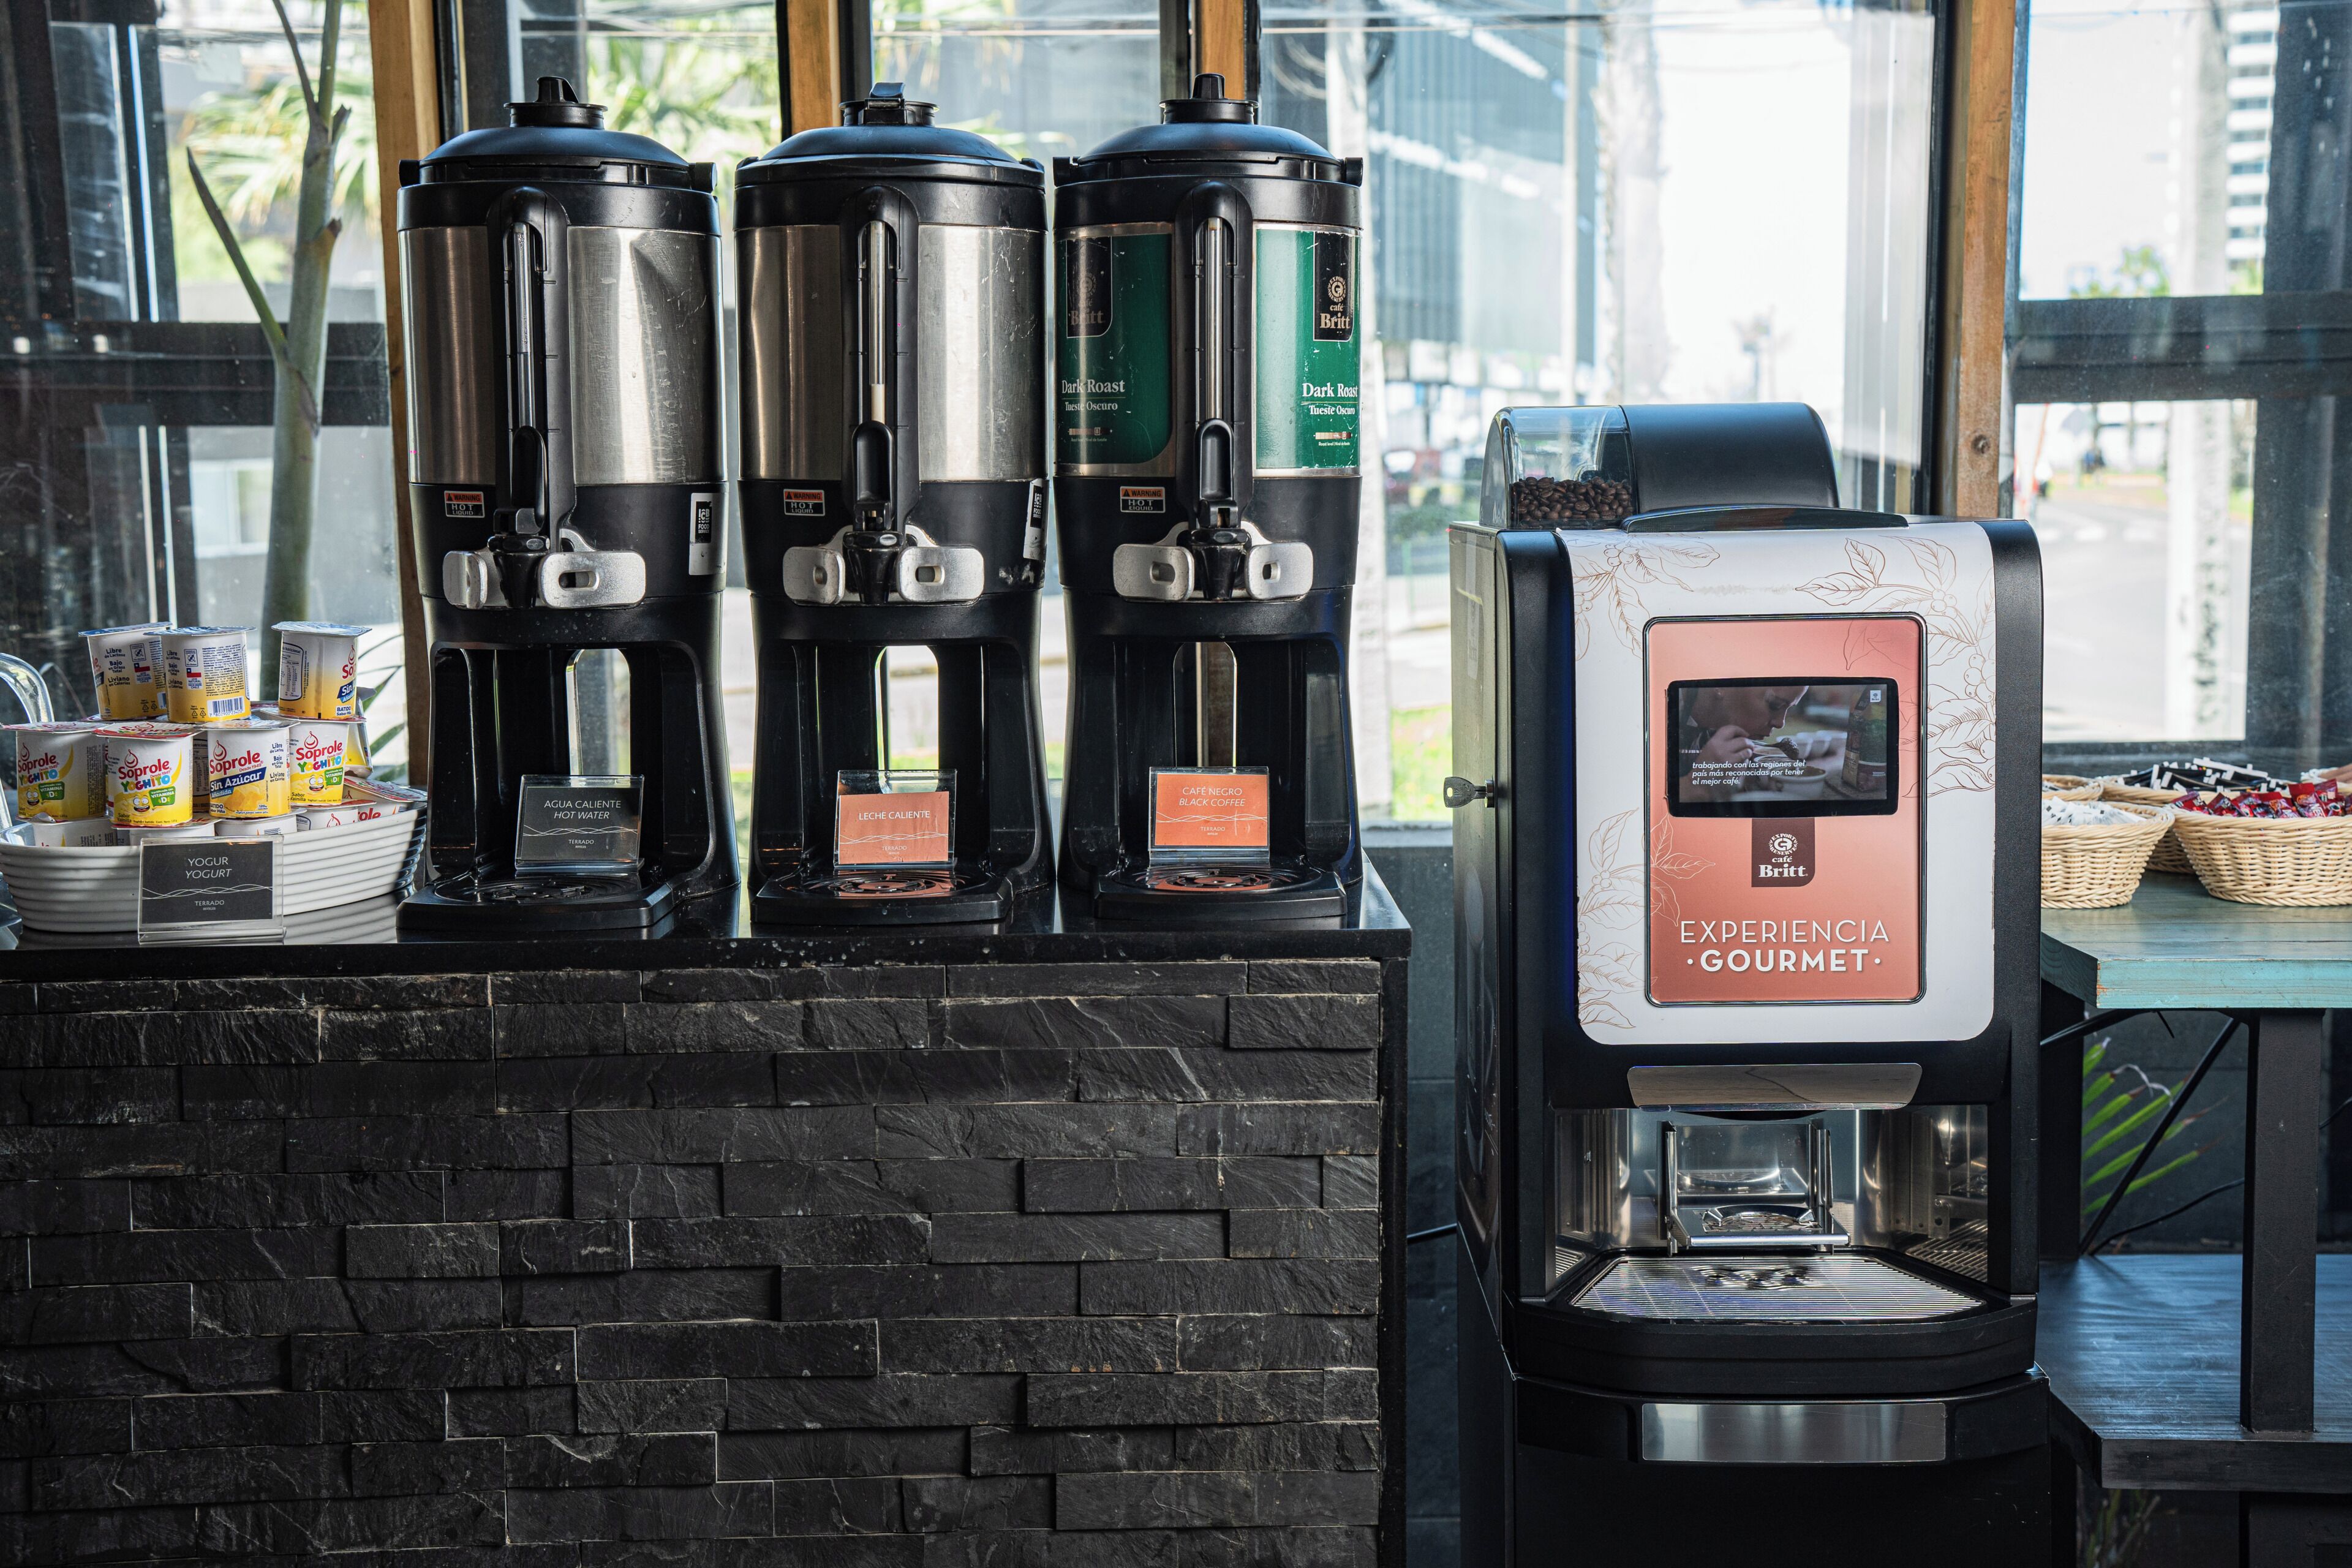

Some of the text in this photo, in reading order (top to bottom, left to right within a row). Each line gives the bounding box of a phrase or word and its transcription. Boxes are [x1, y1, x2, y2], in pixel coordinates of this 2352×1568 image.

[1320, 312, 1351, 328] Britt
[1062, 379, 1125, 393] Dark Roast
[1302, 382, 1358, 398] Dark Roast
[1065, 401, 1118, 411] Tueste Oscuro
[1309, 405, 1355, 415] Tueste Oscuro
[341, 684, 352, 696] Sin
[296, 740, 342, 761] Soprole
[18, 752, 56, 774] Soprole
[118, 758, 170, 781] Soprole
[209, 750, 260, 775] Soprole
[298, 756, 342, 772] YOGHITO
[1692, 761, 1732, 770] trabajando
[20, 769, 58, 785] YOGHITO
[1692, 769, 1707, 778] país
[121, 775, 170, 792] YOGHITO
[211, 772, 262, 791] Sin Azúcar
[1723, 777, 1740, 786] café.
[211, 789, 232, 798] Añadida
[1182, 786, 1206, 796] CAFÉ
[358, 808, 381, 821] ole
[859, 810, 930, 820] LECHE CALIENTE
[1771, 833, 1796, 842] EXPORT
[187, 856, 228, 867] YOGUR
[186, 868, 233, 879] YOGURT
[1758, 863, 1806, 877] Britt
[1681, 919, 1890, 943] EXPERIENCIA
[1700, 949, 1869, 973] GOURMET
